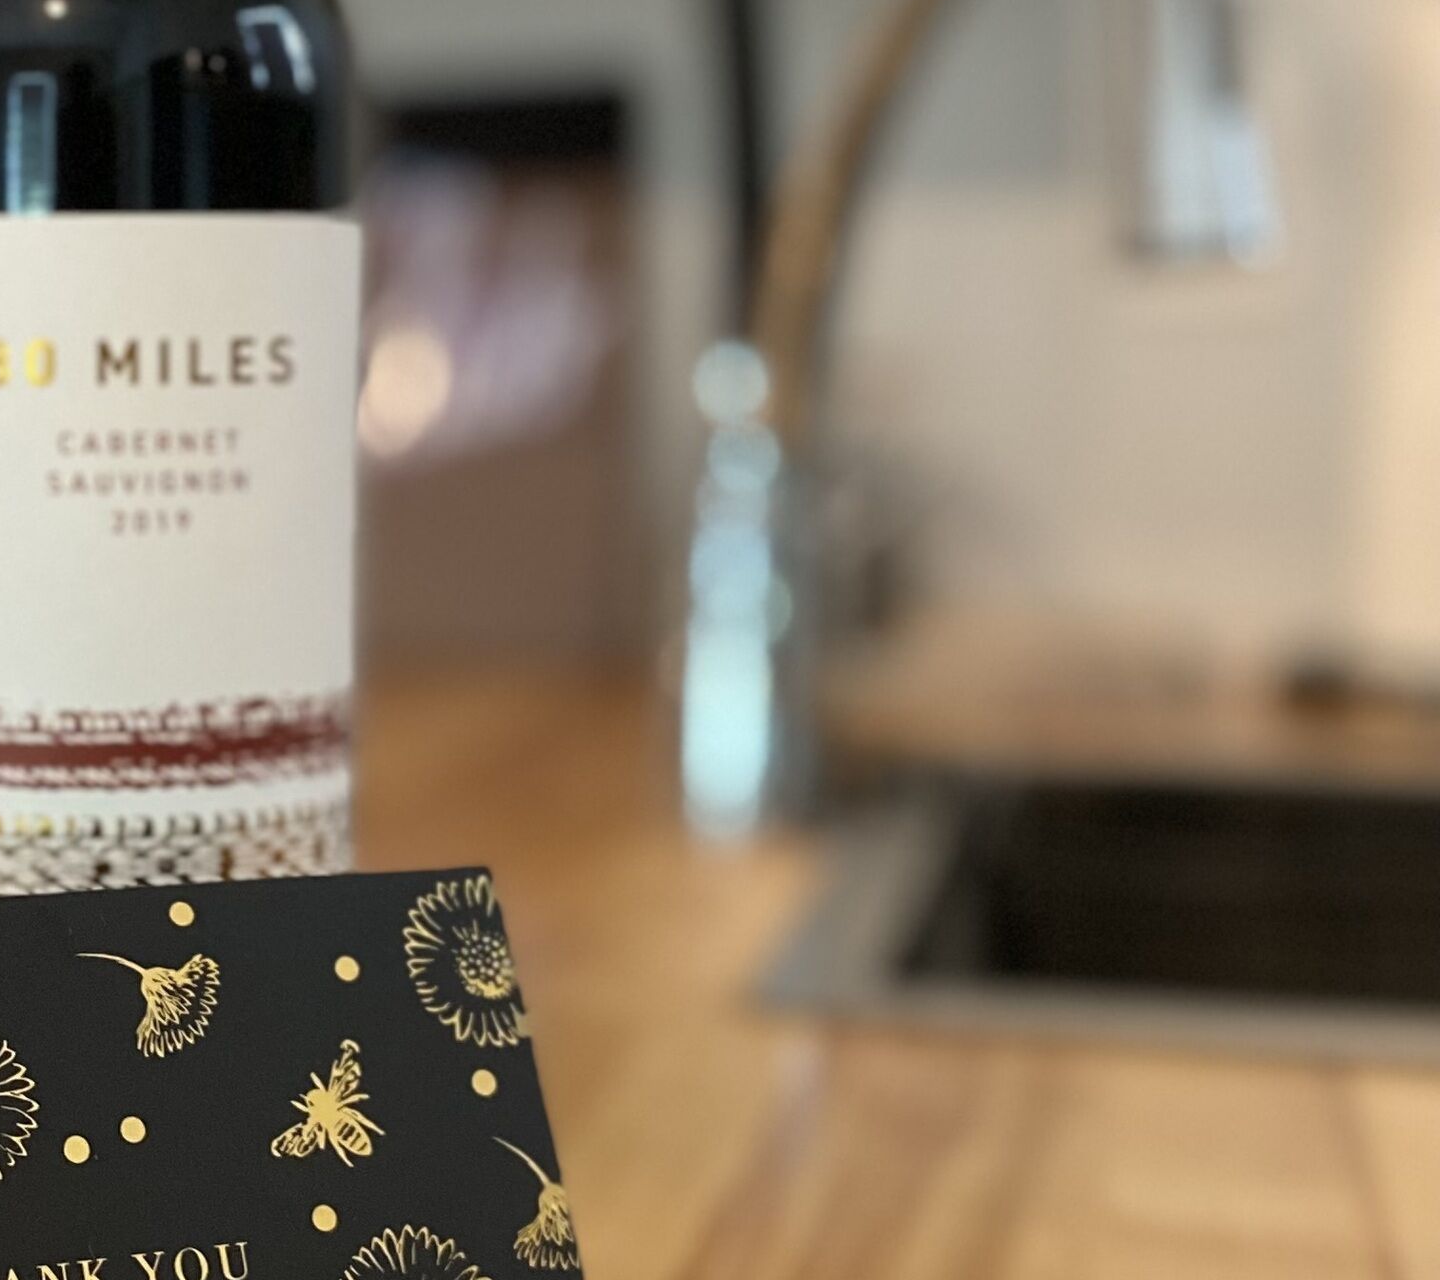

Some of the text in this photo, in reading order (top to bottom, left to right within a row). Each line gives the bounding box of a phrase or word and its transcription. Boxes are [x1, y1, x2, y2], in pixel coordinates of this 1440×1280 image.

[96, 335, 296, 387] MILES
[57, 428, 239, 455] CABERNET
[47, 469, 250, 496] SAUVIGNON
